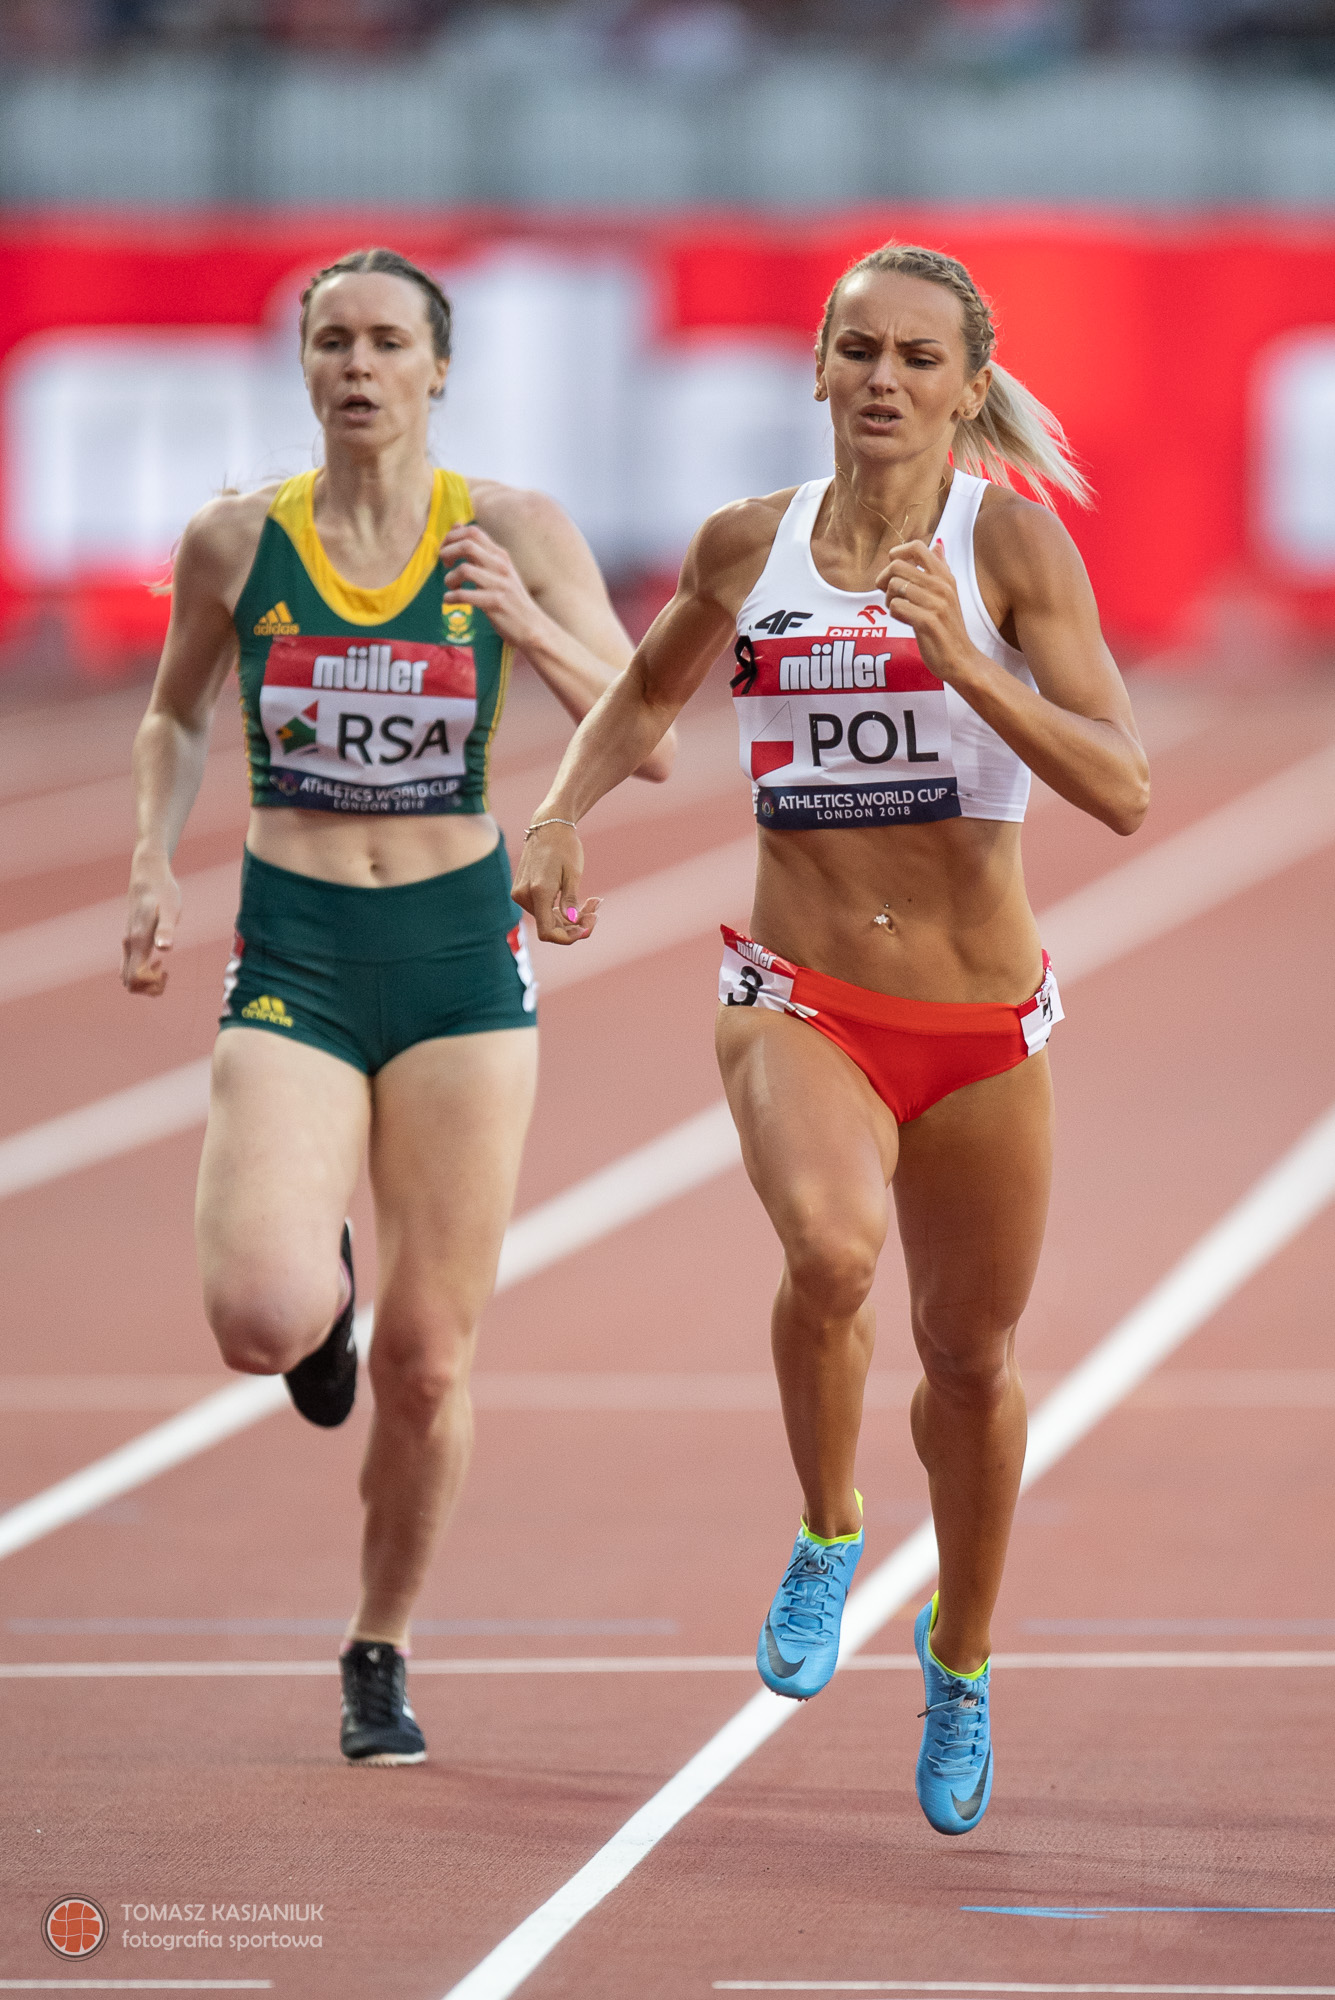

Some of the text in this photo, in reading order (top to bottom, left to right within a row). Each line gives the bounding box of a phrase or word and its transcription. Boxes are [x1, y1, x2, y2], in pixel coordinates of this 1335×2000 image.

[253, 622, 300, 636] adidas
[755, 609, 814, 635] 4F
[311, 643, 430, 695] müller
[779, 640, 892, 691] müller
[336, 712, 451, 767] RSA
[808, 709, 940, 767] POL
[300, 776, 461, 802] ATHLETICS WORLD CUP
[778, 787, 948, 810] ATHLETICS WORLD CUP
[333, 799, 427, 812] LONDON 2018
[816, 805, 912, 820] LONDON 2018
[735, 940, 777, 970] müller
[727, 965, 764, 1006] 3
[241, 1006, 294, 1028] adidas
